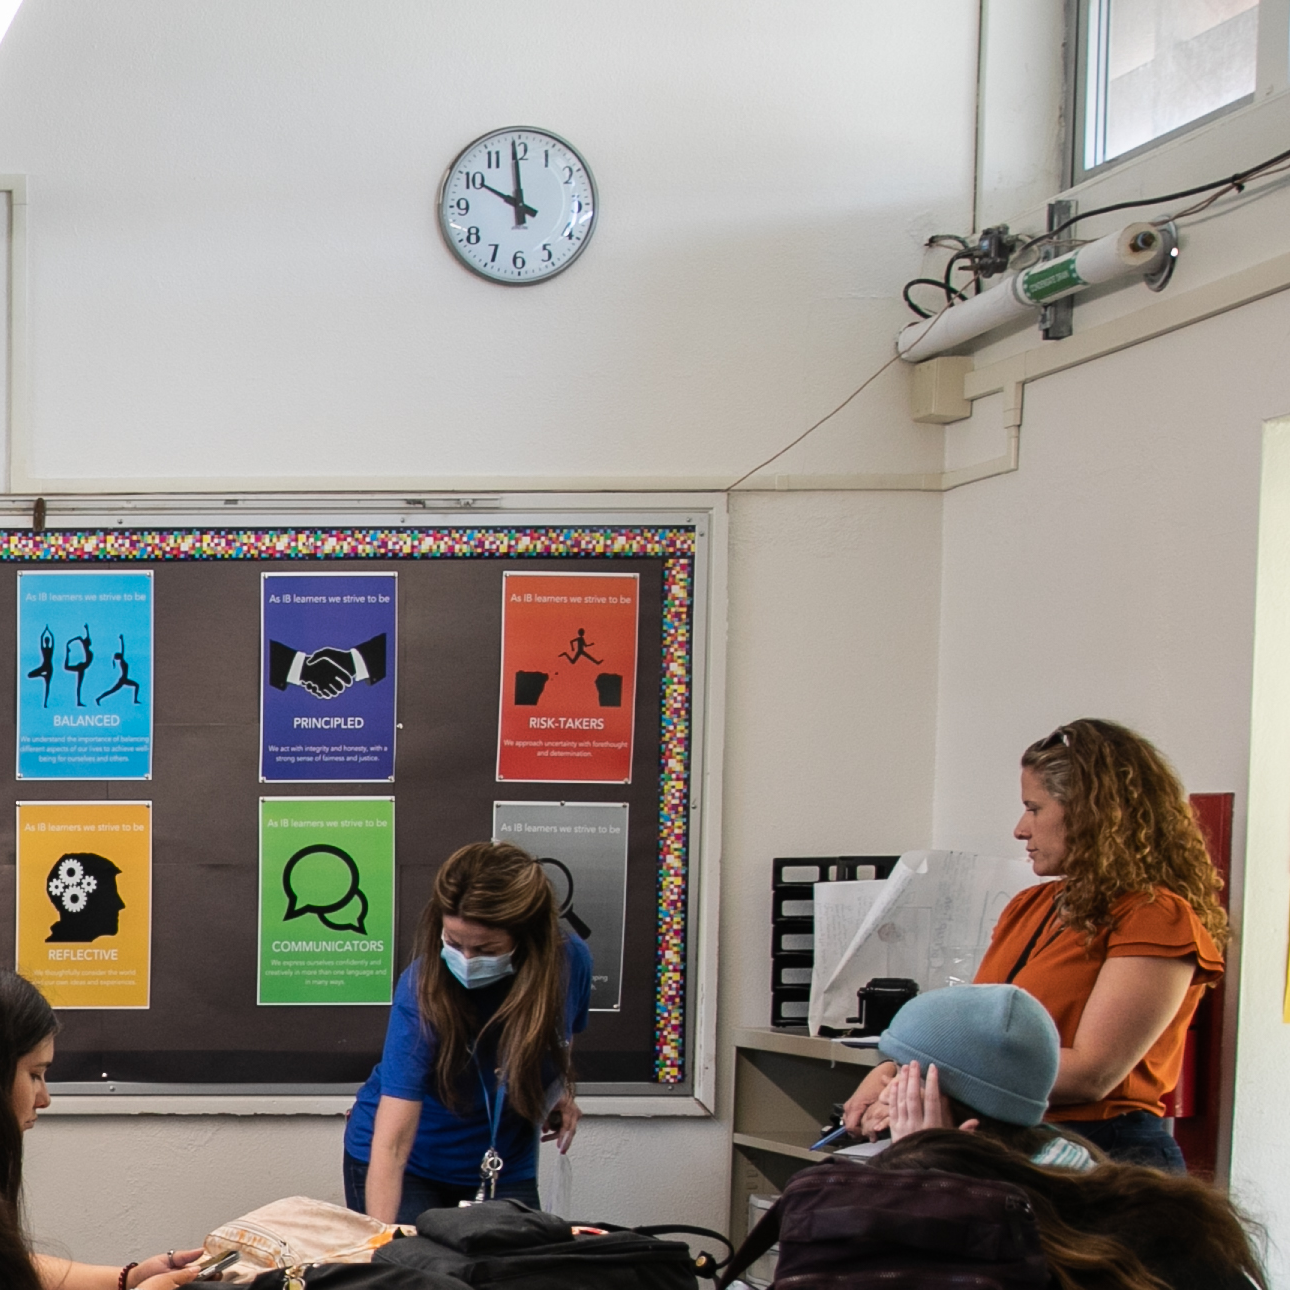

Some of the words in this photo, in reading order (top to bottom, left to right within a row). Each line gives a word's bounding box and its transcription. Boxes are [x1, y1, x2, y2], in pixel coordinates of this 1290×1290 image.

[487, 150, 500, 169] 11
[544, 150, 549, 168] 1
[465, 171, 485, 190] 10
[562, 166, 573, 184] 2
[456, 197, 470, 216] 9
[466, 226, 481, 245] 8
[488, 244, 499, 262] 7
[541, 244, 552, 262] 5
[512, 251, 526, 269] 6
[25, 593, 36, 601] As
[39, 592, 47, 601] IB
[49, 592, 82, 601] learners
[99, 593, 122, 601] strive
[124, 593, 133, 601] to
[135, 592, 147, 601] be
[269, 593, 281, 603] As
[283, 593, 291, 603] IB
[293, 593, 327, 603] learners
[328, 595, 341, 603] we
[343, 594, 365, 603] strive
[367, 595, 377, 603] to
[379, 593, 390, 602] be
[511, 593, 522, 602] As
[523, 593, 533, 602] IB
[534, 593, 568, 603] learners
[584, 594, 607, 603] strive
[609, 595, 618, 604] to
[620, 594, 631, 604] be
[53, 715, 120, 727] BALANCED
[293, 717, 364, 729] PRINCIPLED
[529, 717, 605, 730] RISK-TAKERS
[24, 822, 36, 832] As
[37, 821, 47, 832] IB
[47, 822, 82, 832] learners
[97, 823, 121, 831] strive
[121, 823, 132, 831] to
[132, 822, 144, 831] be
[267, 818, 279, 828] As
[280, 817, 289, 828] IB
[291, 818, 325, 828] learners
[341, 819, 363, 827] strive
[365, 819, 374, 827] to
[376, 818, 387, 827] be
[501, 822, 512, 832] As
[514, 822, 523, 832] IB
[525, 822, 557, 832] learners
[574, 824, 596, 833] strive
[598, 825, 607, 833] to
[609, 824, 620, 833] be
[271, 941, 384, 952] COMMUNICATORS
[48, 949, 118, 961] REFLECTIVE
